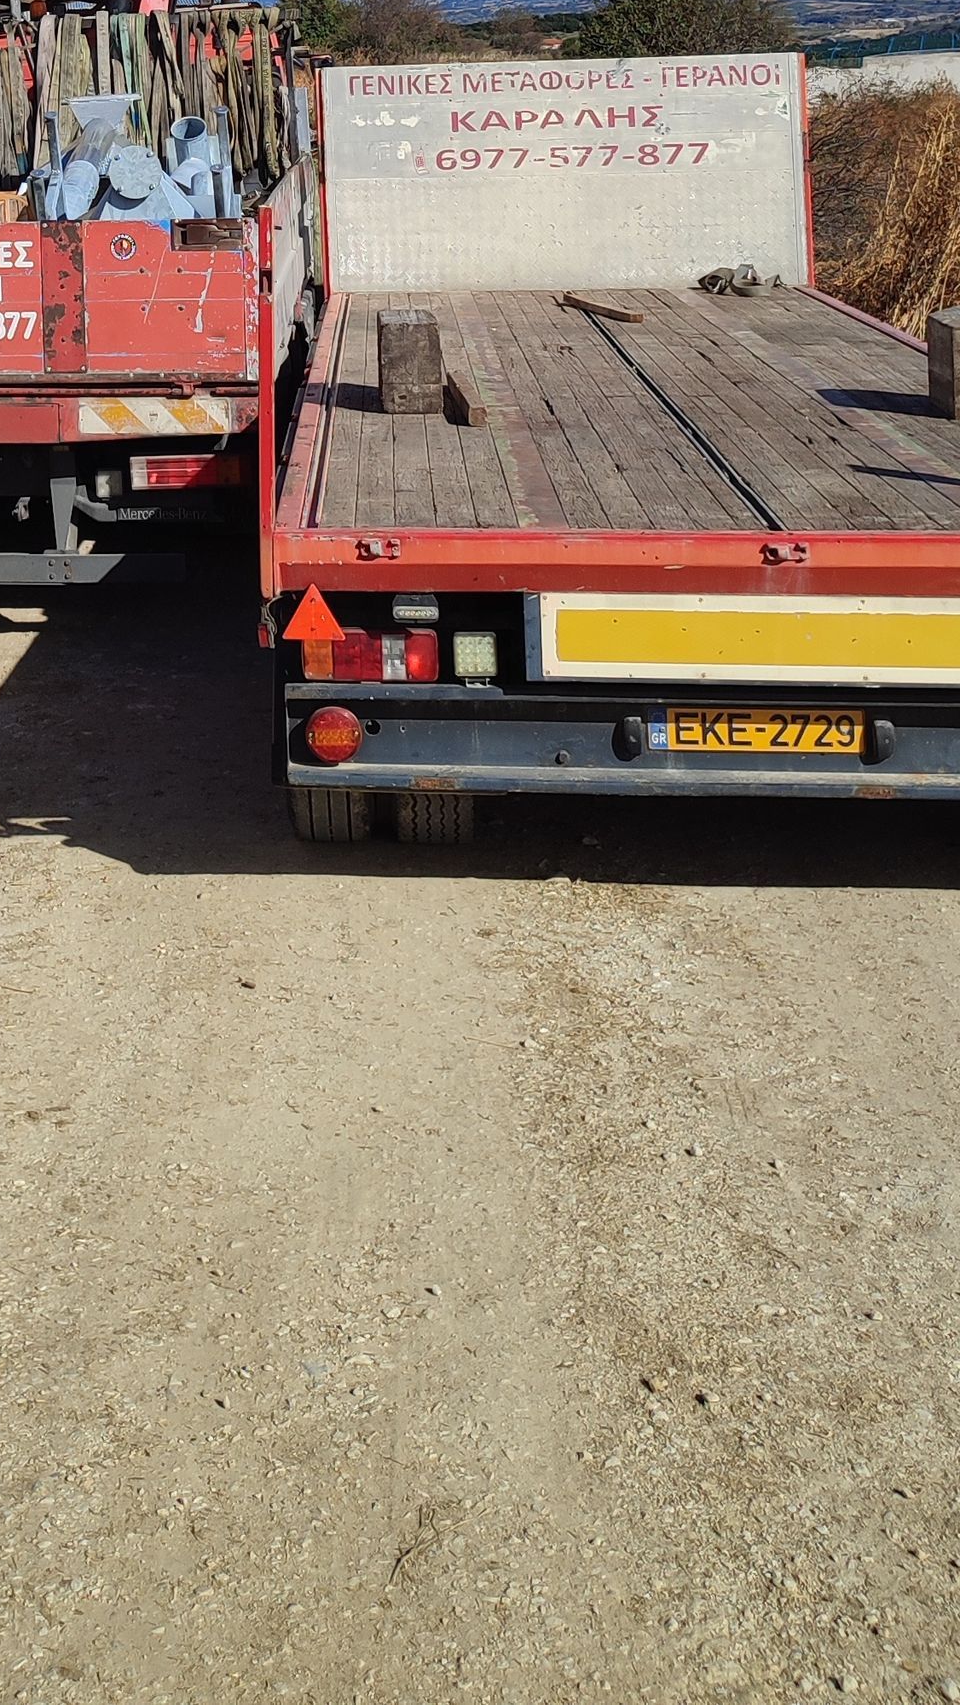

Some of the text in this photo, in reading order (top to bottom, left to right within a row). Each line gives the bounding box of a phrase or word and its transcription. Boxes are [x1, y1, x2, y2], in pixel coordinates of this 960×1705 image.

[348, 73, 453, 96] ΓΕΝΙΚΕΣ
[462, 68, 635, 94] ΜΕΤΑΦΟΡΕΣ
[661, 63, 781, 89] ΓΕΡΑΝΟΙ
[450, 105, 664, 133] ΚΑΡΑΛΗΣ
[435, 142, 710, 171] 6977-577-877
[651, 732, 667, 743] GR
[674, 712, 855, 747] EKE-2729
